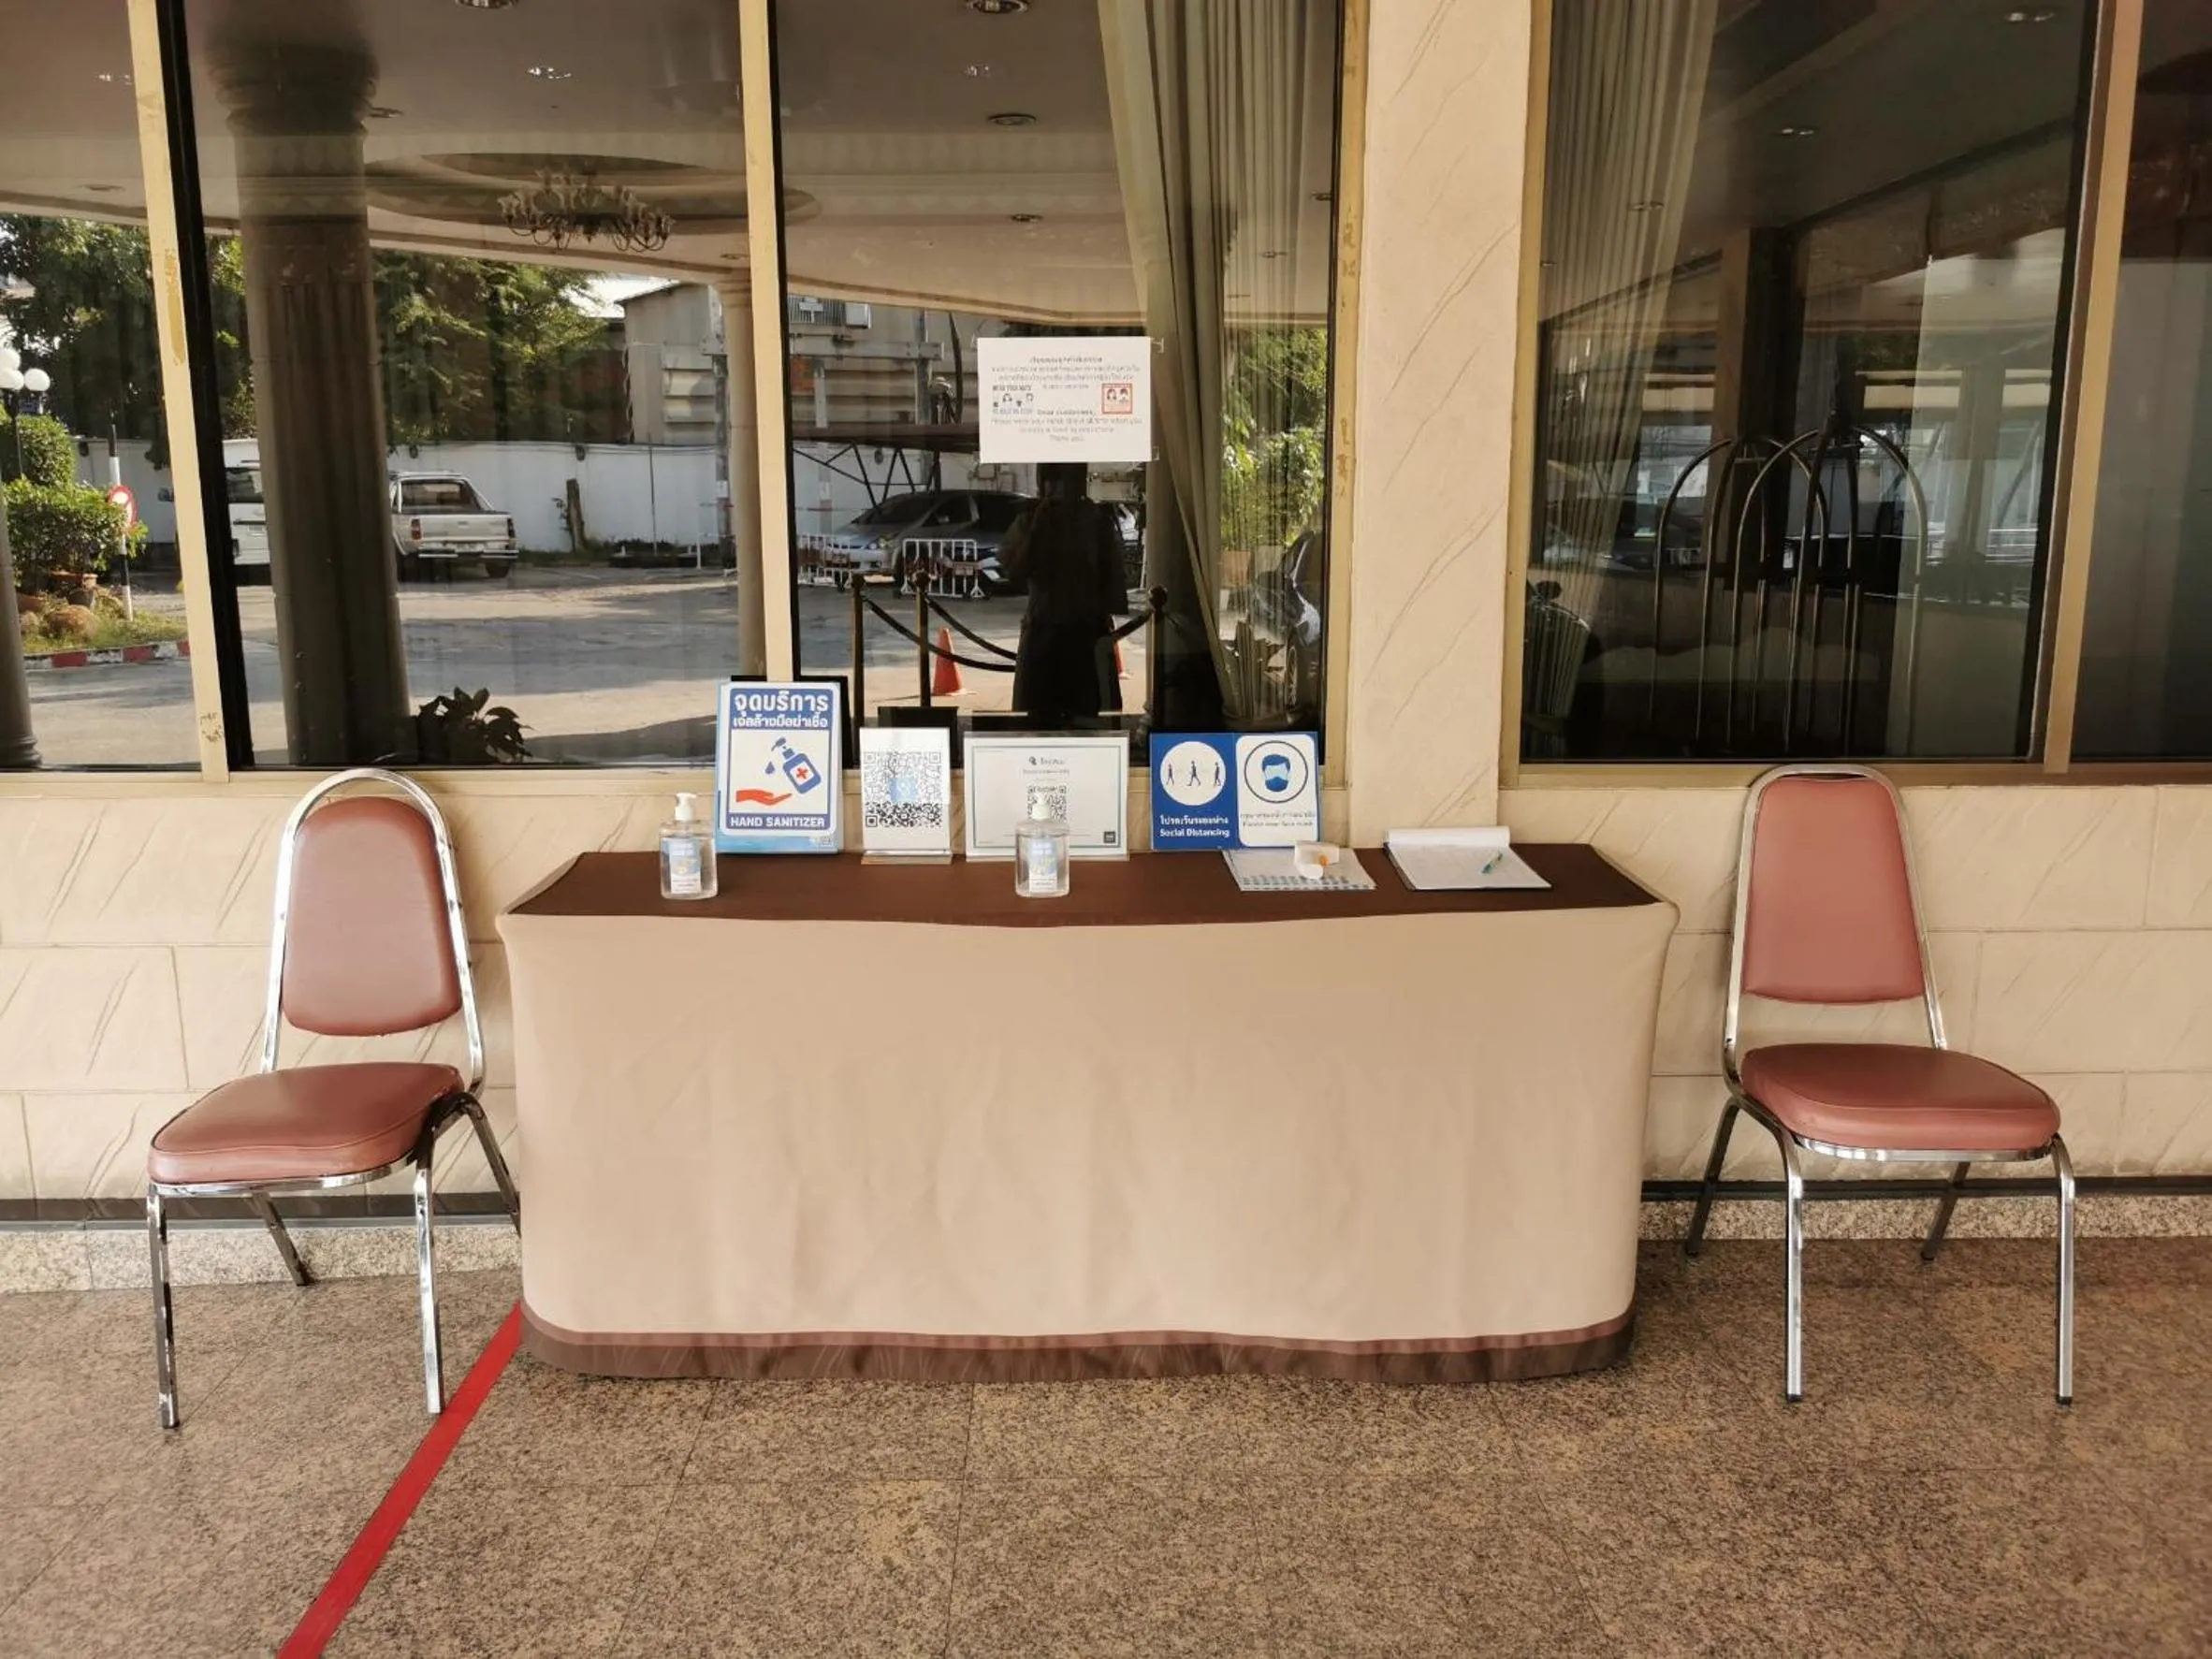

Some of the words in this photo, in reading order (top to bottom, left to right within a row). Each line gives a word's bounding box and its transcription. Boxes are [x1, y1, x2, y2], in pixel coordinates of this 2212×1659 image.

[735, 691, 829, 718] จุดบริการ
[730, 816, 764, 827] HAND
[765, 816, 825, 828] SANITIZER
[1159, 828, 1185, 837] Social
[1186, 828, 1230, 838] Distancing
